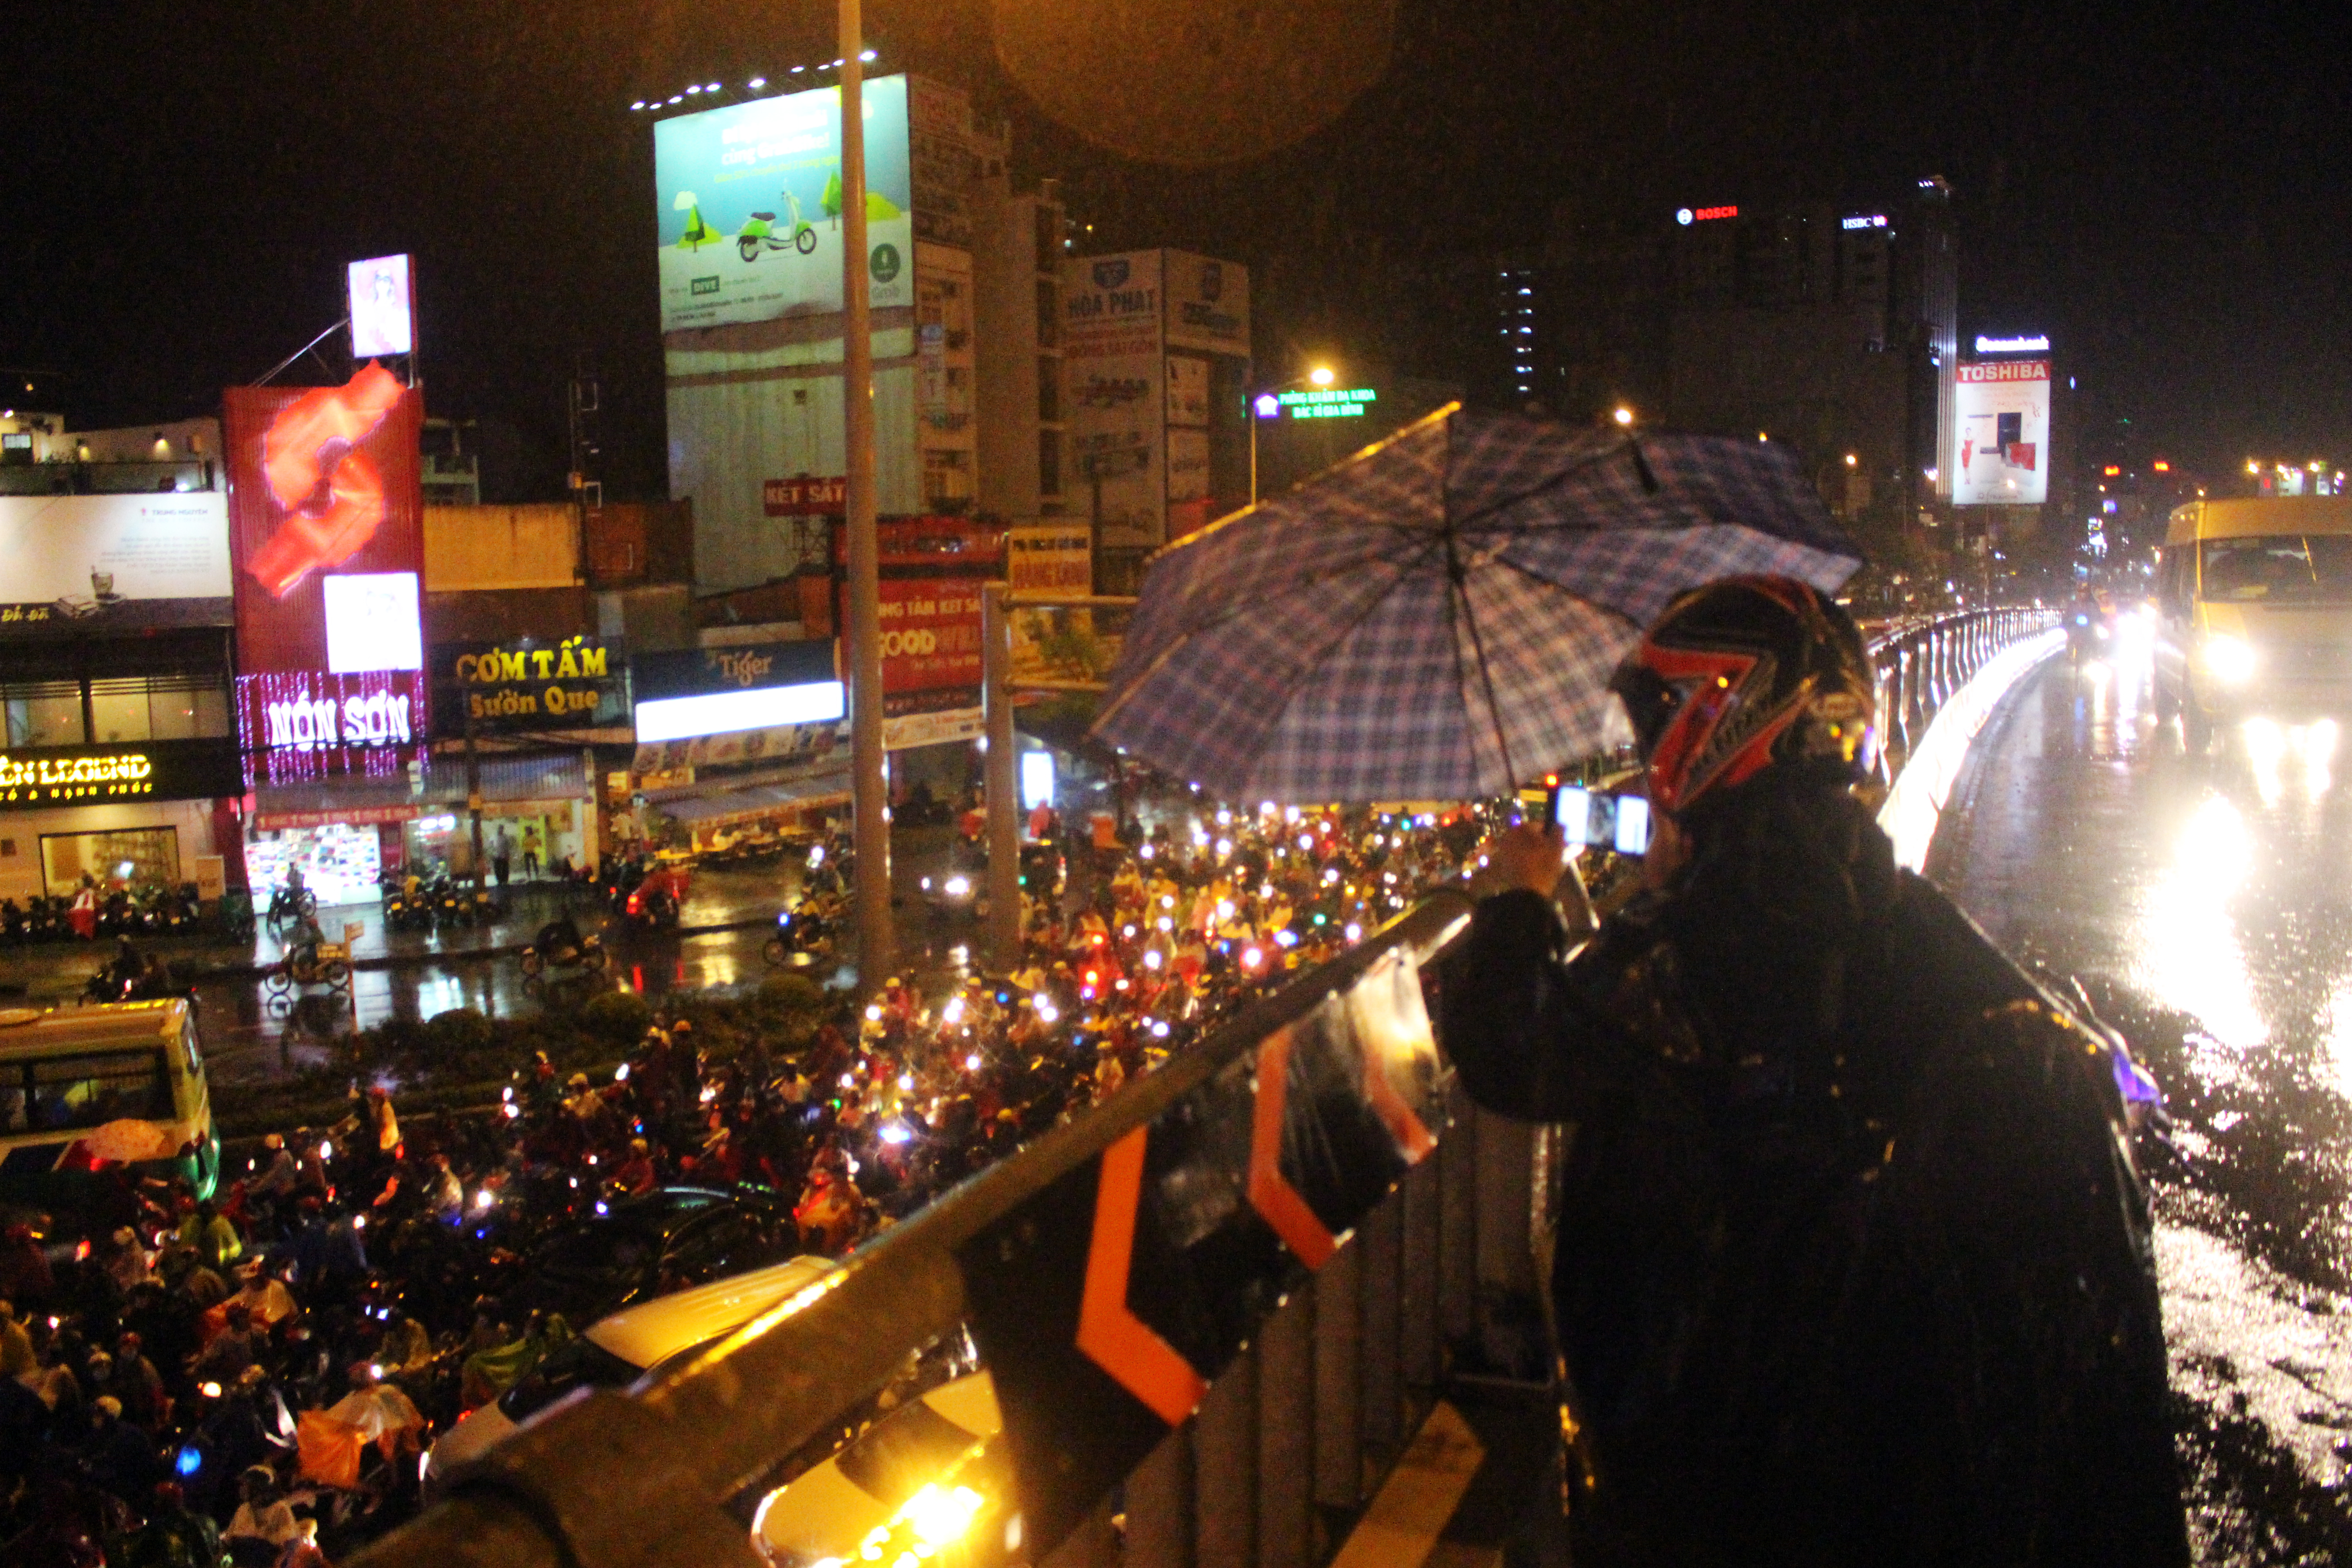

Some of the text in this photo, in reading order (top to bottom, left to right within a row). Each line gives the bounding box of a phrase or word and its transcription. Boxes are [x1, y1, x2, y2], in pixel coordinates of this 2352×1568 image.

[1695, 205, 1738, 220] BOSCH
[1842, 216, 1872, 230] HSBC
[1959, 363, 2047, 382] TOSHIBA
[456, 635, 607, 682] CƠM TẤM
[717, 650, 773, 687] Tiger
[268, 688, 412, 752] NÓN SƠN
[38, 754, 152, 785] LEGEND
